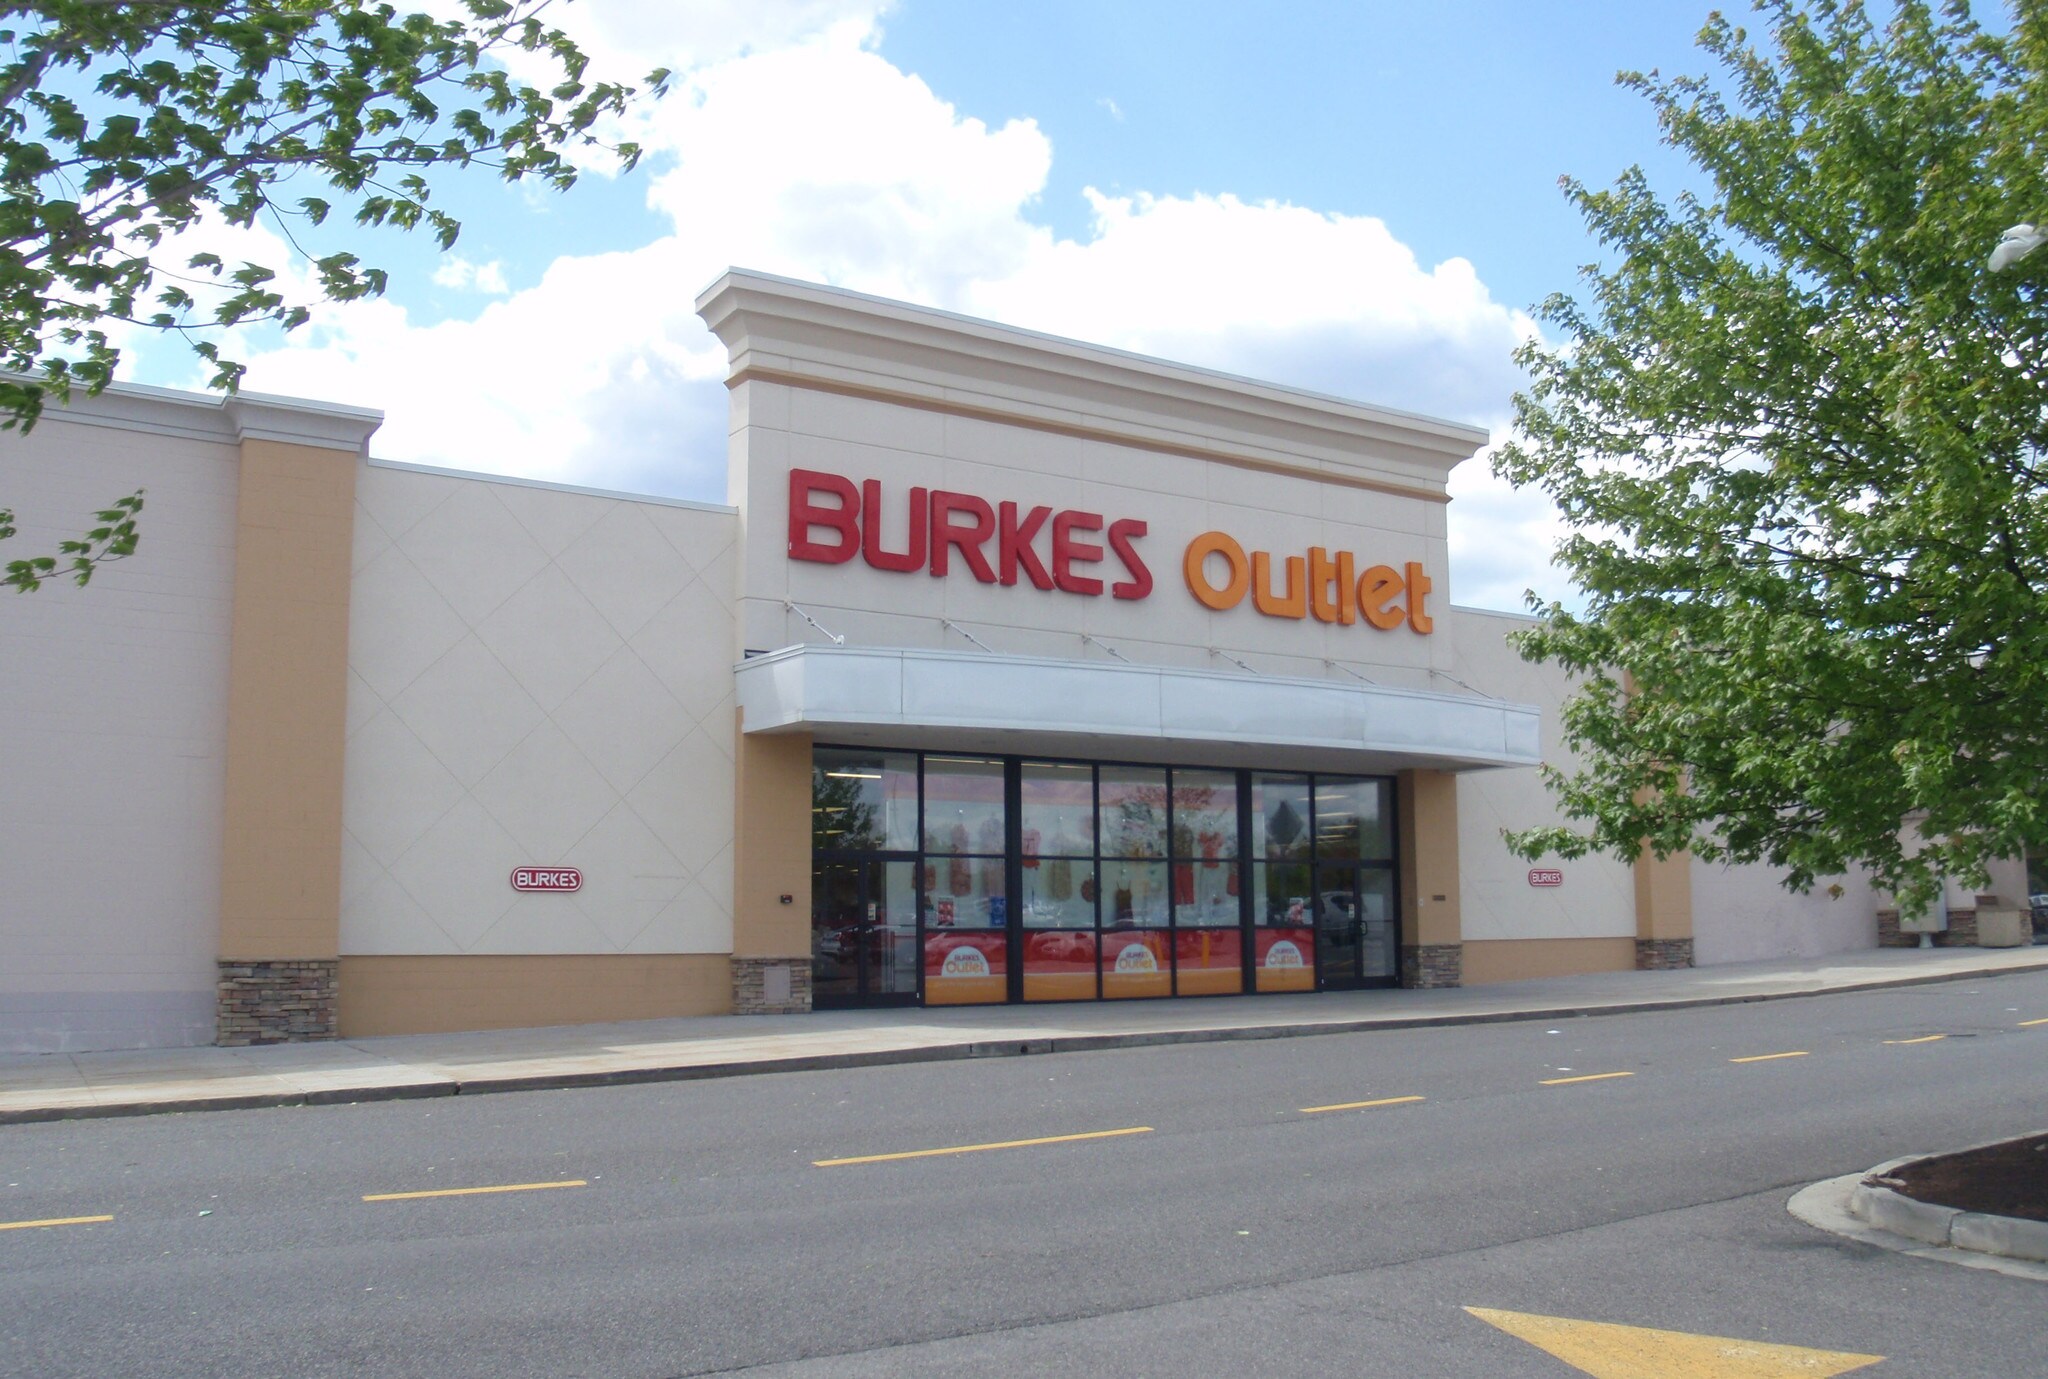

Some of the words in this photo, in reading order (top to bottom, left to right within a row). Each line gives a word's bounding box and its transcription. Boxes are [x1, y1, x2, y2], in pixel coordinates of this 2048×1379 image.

[788, 468, 1153, 600] BURKES
[1183, 531, 1433, 634] Outlet
[516, 872, 577, 887] BURKES
